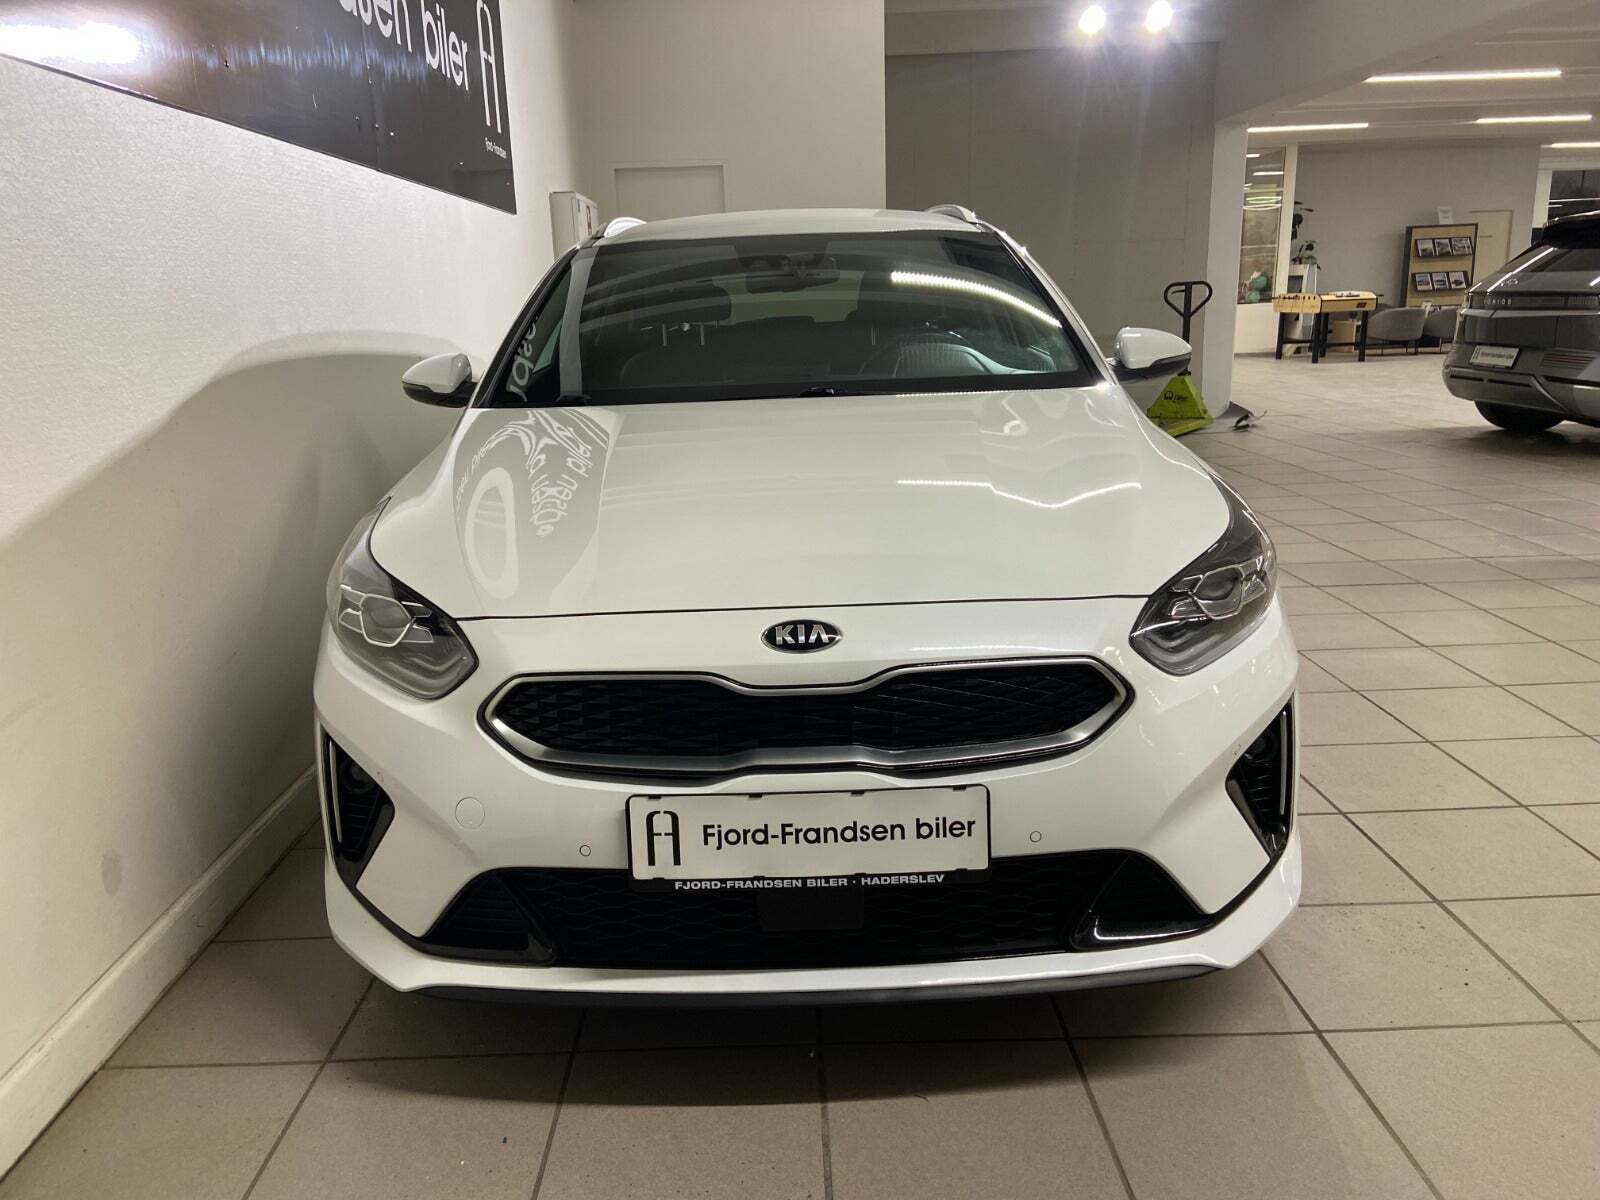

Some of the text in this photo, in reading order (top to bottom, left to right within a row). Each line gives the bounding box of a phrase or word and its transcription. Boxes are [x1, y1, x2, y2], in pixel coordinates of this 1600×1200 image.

[340, 0, 468, 90] en biler
[775, 623, 830, 645] KIA
[702, 816, 976, 850] Fjord-Frandsen biler
[674, 873, 945, 890] FJORD-FRANDSEN BILER HADERSLEV
